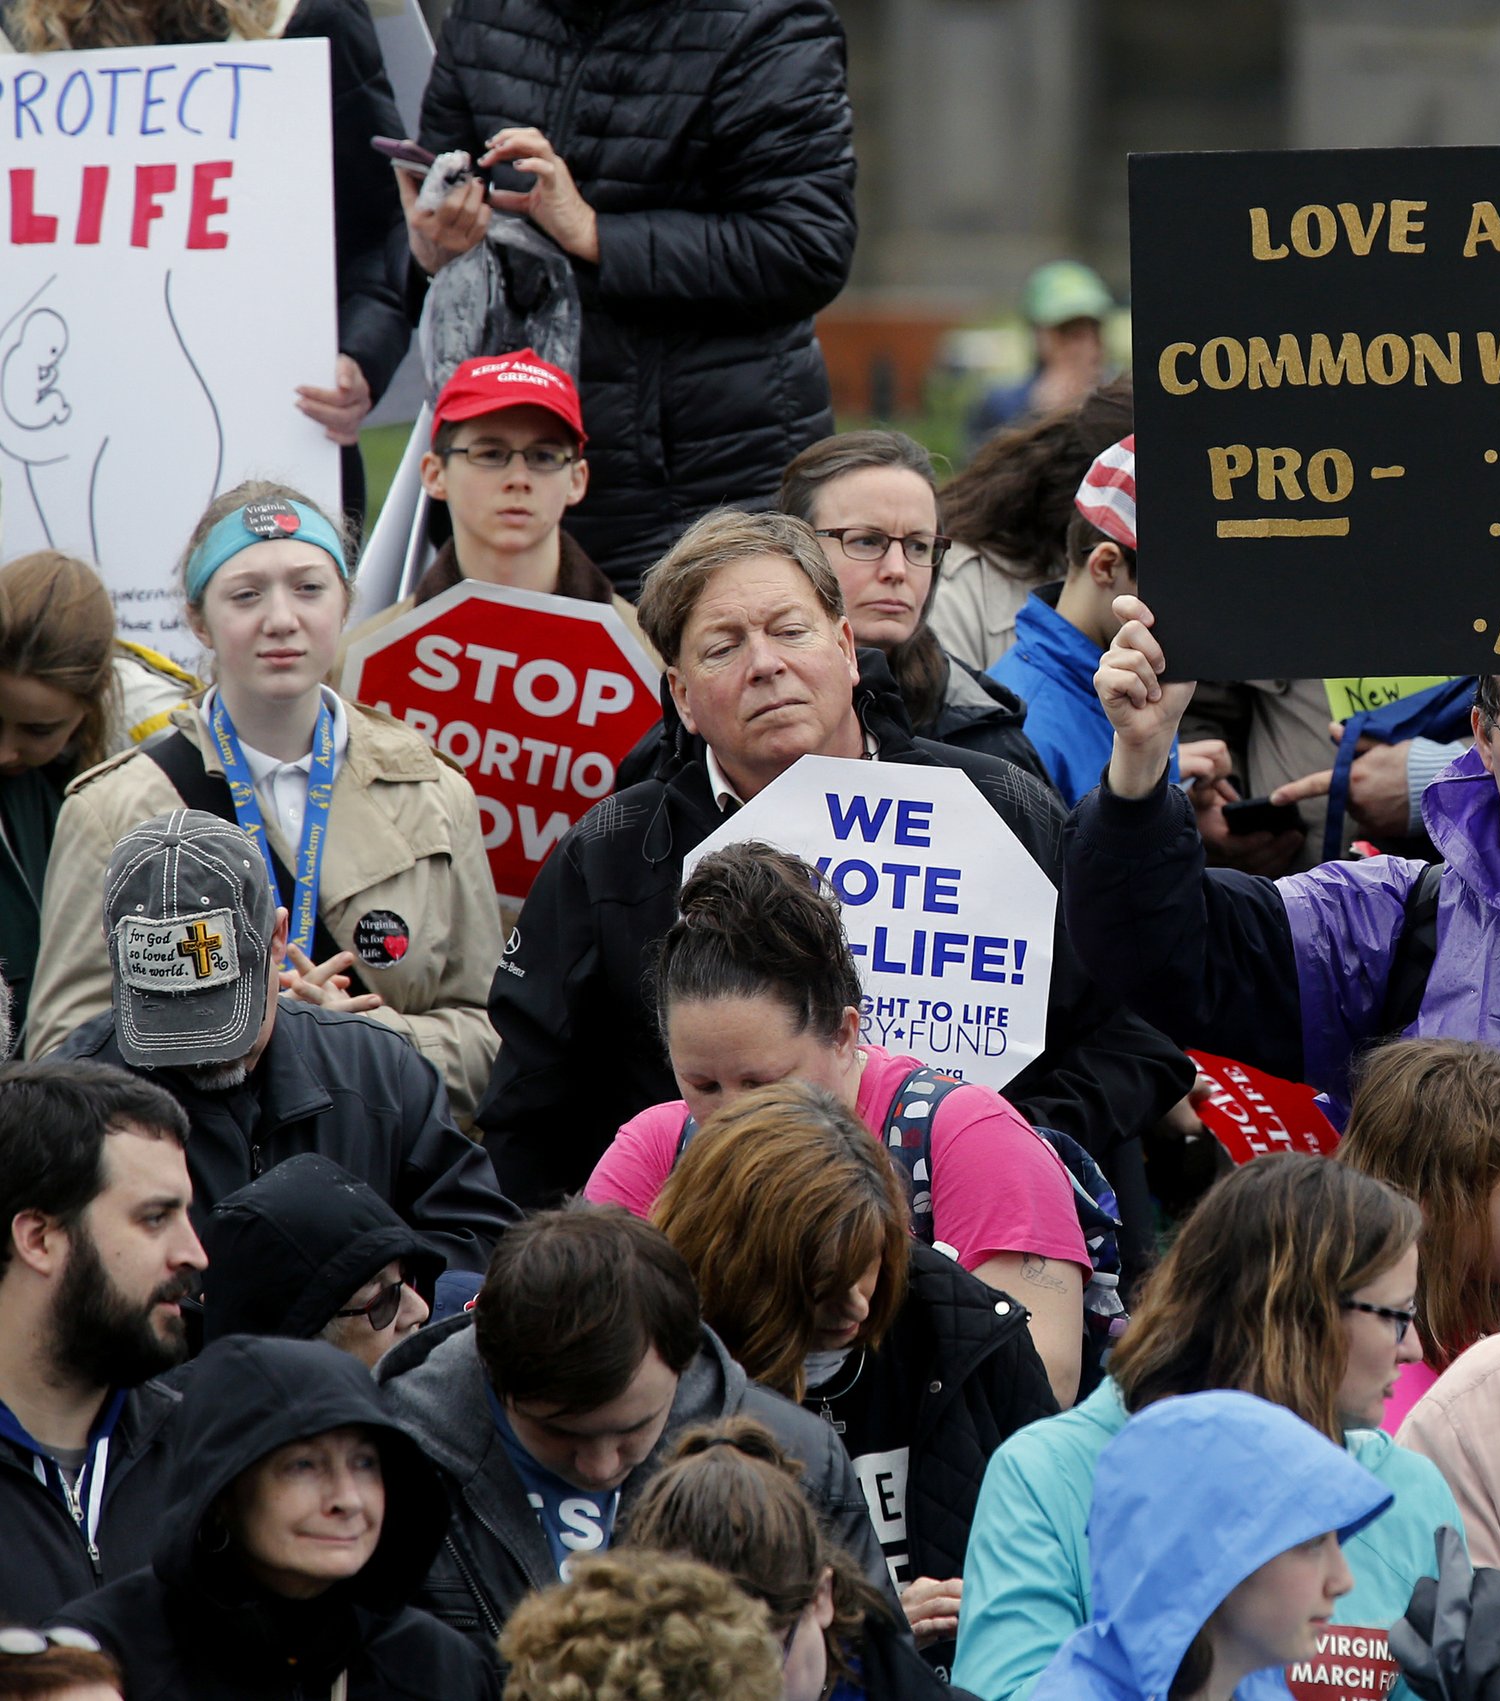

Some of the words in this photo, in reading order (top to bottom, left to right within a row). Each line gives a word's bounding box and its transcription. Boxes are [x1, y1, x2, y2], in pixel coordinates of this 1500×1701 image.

[0, 62, 272, 140] ROTECT
[8, 160, 234, 251] LIFE
[1249, 200, 1427, 260] LOVE
[1159, 331, 1462, 395] COMMON
[408, 634, 634, 727] STOP
[825, 793, 934, 848] WE
[298, 823, 324, 885] Academy
[292, 889, 313, 948] Angelus
[359, 920, 398, 930] Virginia
[129, 928, 145, 944] for
[147, 931, 172, 947] God
[360, 934, 368, 943] is
[370, 934, 384, 944] for
[362, 948, 381, 958] Life
[129, 950, 140, 959] so
[143, 948, 175, 962] loved
[132, 963, 147, 975] the
[149, 963, 189, 977] world.
[918, 1000, 952, 1022] TO
[963, 1004, 1009, 1028] LIFE
[908, 1019, 1007, 1057] FUND
[1316, 1634, 1396, 1662] VIRGIN
[1291, 1662, 1375, 1690] MARCH
[1380, 1671, 1400, 1692] FO
